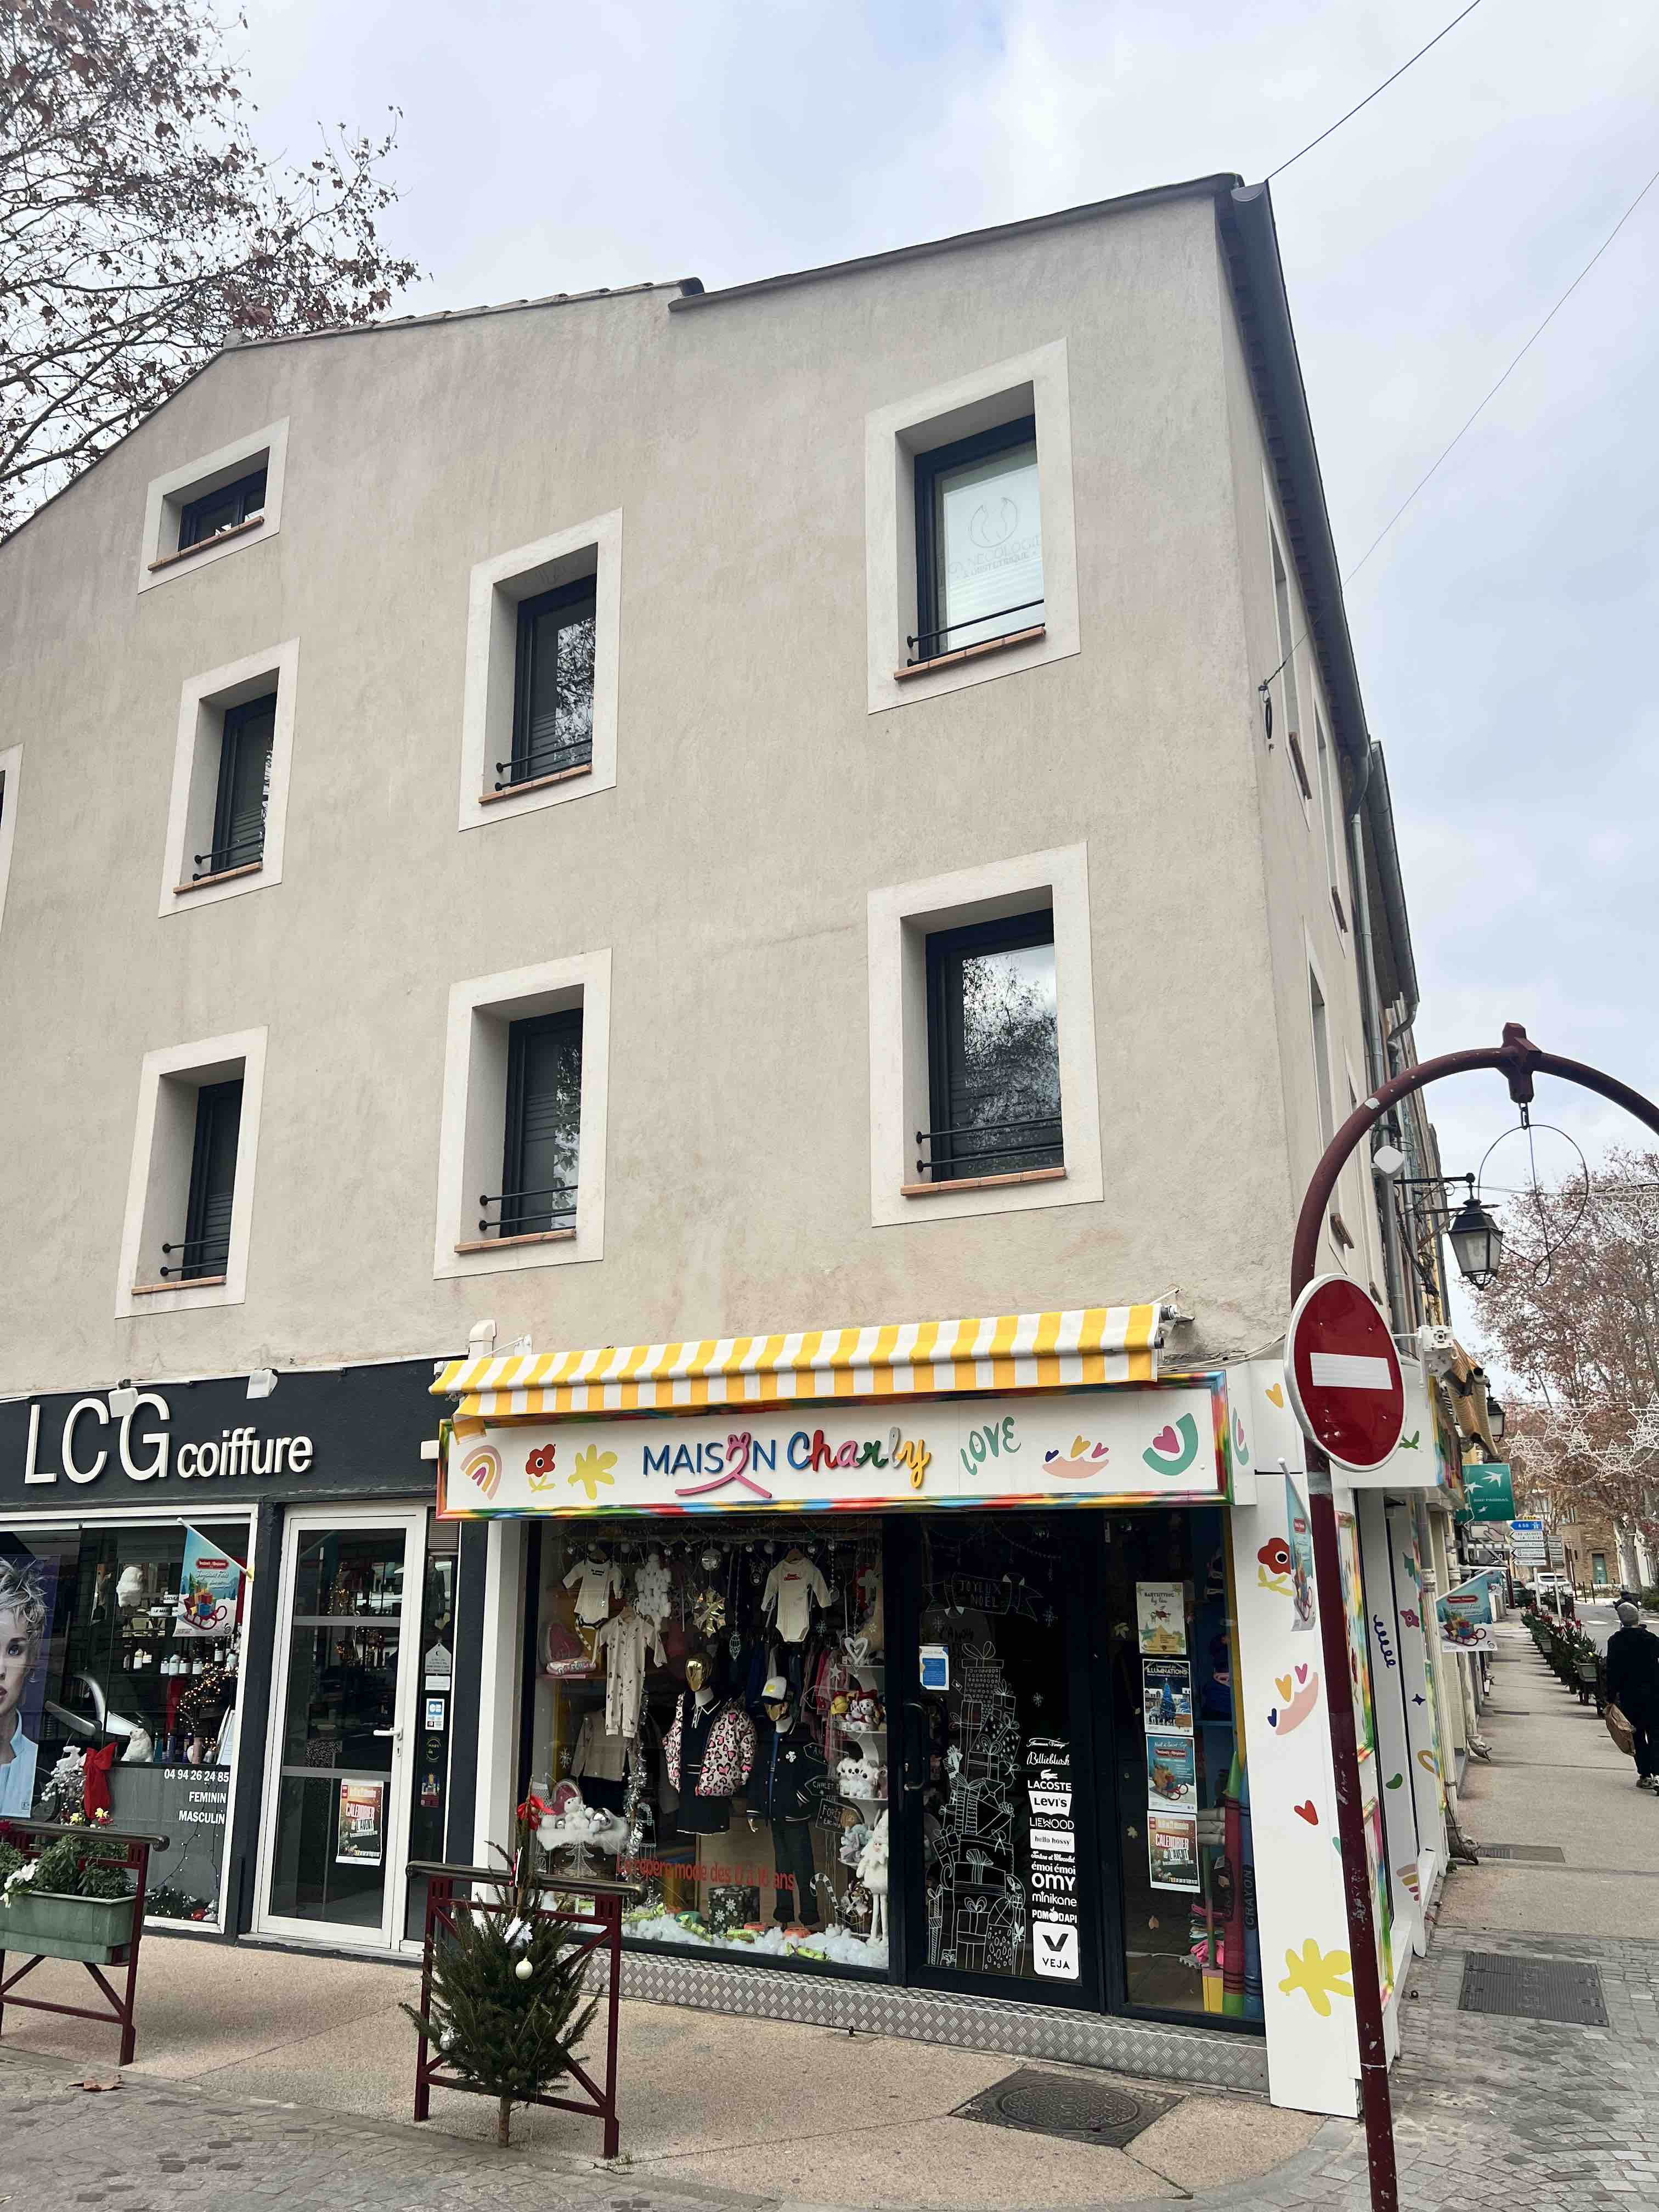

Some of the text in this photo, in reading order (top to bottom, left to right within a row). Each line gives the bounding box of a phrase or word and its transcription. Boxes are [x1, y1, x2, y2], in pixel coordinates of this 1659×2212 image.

[25, 1393, 313, 1483] LCG coiffure
[787, 1427, 932, 1489] Charly
[1026, 1751, 1070, 1765] Billieblush
[164, 1768, 229, 1782] 04 94 26 24 85
[1028, 1780, 1072, 1791] LACOSTE
[189, 1791, 227, 1804] FEMININ
[178, 1810, 225, 1825] MASCULIN
[1030, 1817, 1074, 1830] LIEWOOD
[1052, 1837, 1070, 1846] hossy
[1031, 1861, 1076, 1875] émoi émoi
[773, 1871, 795, 1891] ans
[1032, 1891, 1077, 1907] minikane
[1042, 1957, 1070, 1970] VEJA
